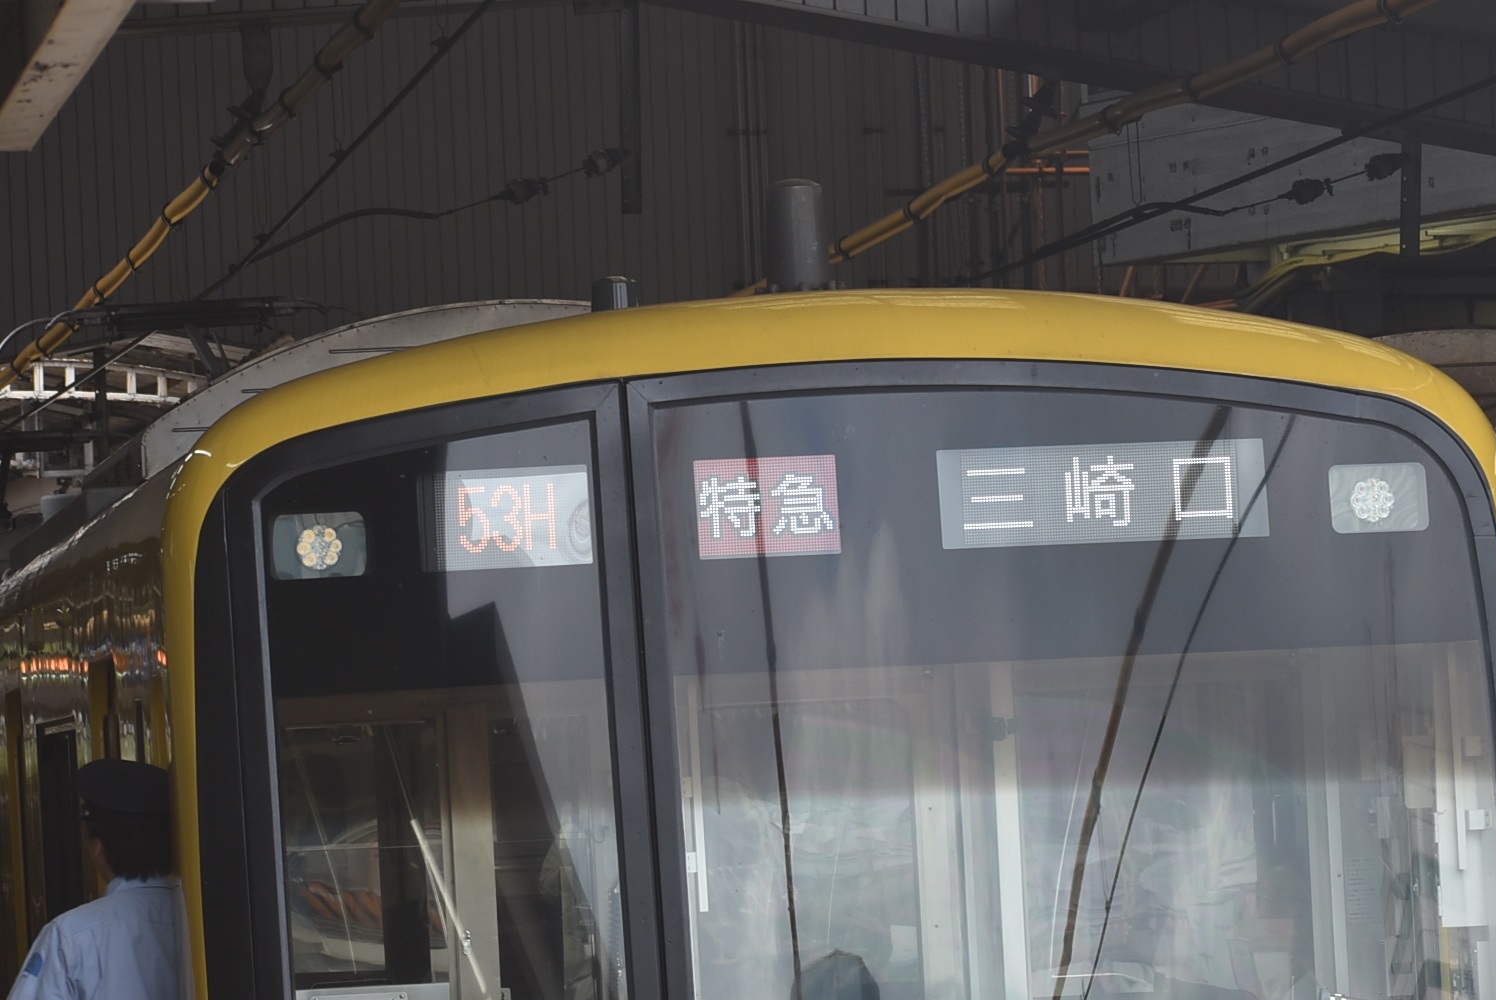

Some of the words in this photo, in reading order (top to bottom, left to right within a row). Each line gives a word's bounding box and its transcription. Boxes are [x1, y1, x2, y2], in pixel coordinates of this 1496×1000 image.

[458, 483, 557, 553] 53H
[699, 474, 834, 539] 特急
[963, 455, 1234, 531] 三崎口
